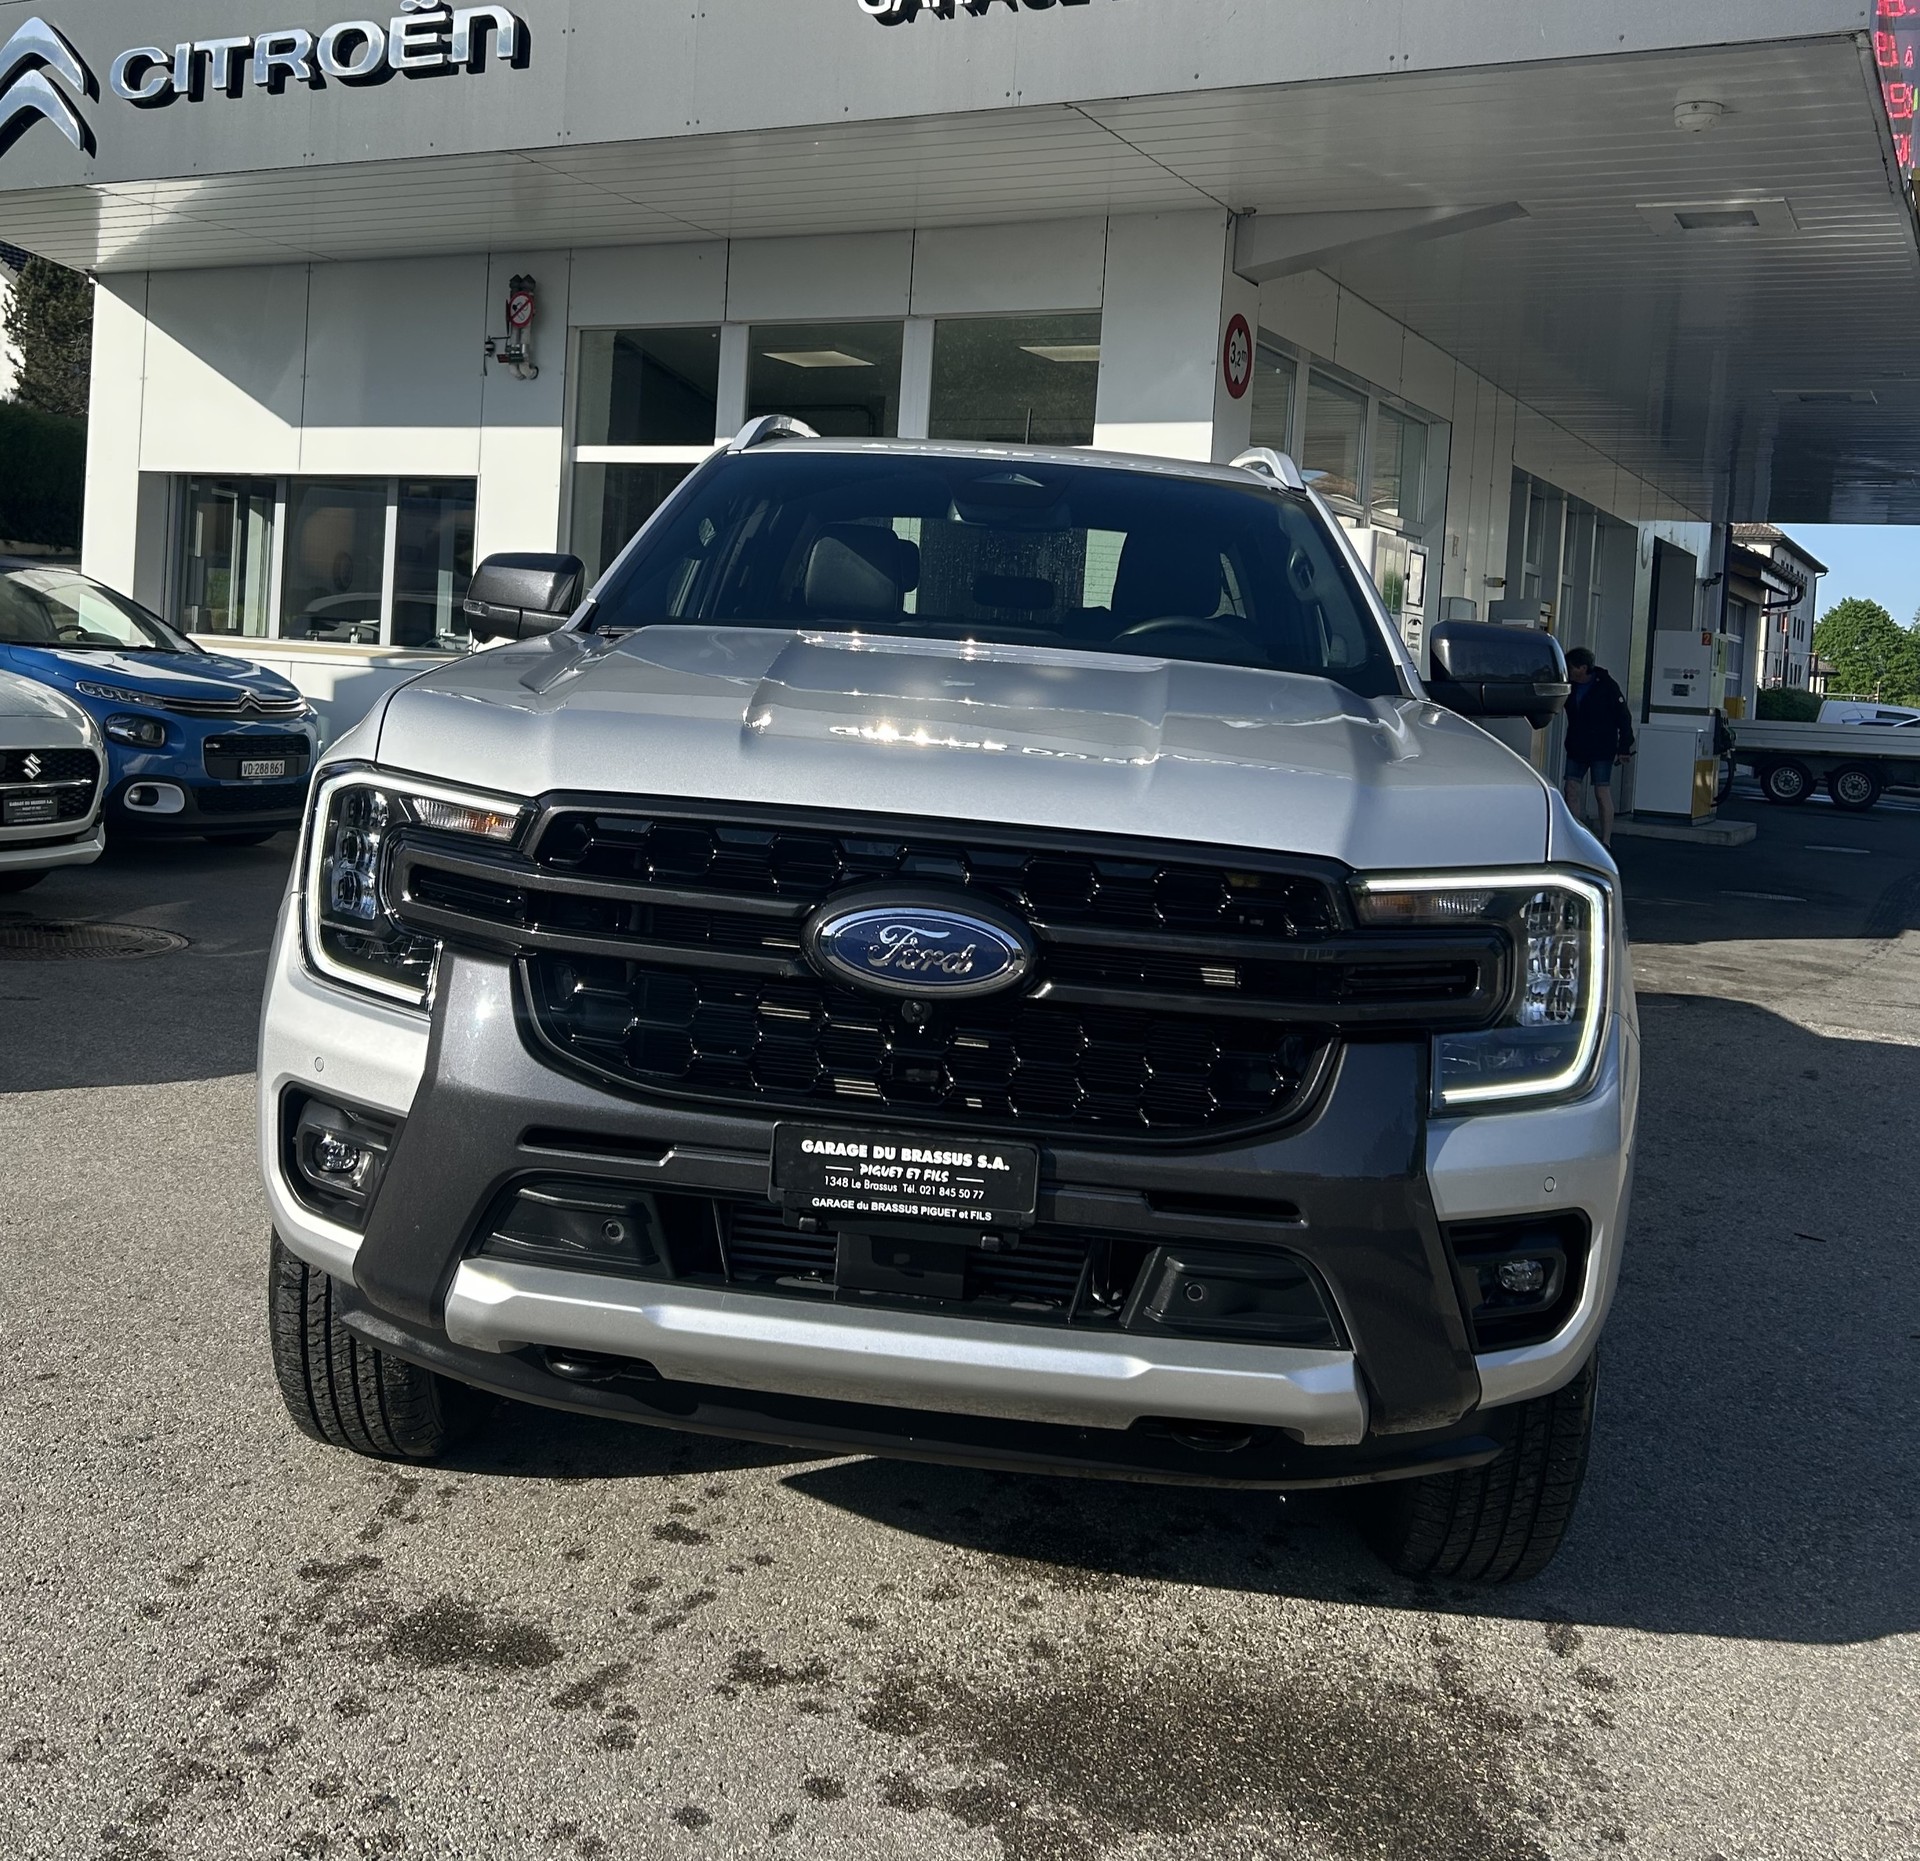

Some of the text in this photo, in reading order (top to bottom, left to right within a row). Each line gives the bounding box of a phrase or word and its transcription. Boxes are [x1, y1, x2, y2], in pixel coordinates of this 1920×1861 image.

[868, 924, 976, 975] Ford
[801, 1139, 1010, 1171] GARAGE DU BRASSUS S.A.
[860, 1163, 949, 1183] PIGUET ET FILS
[825, 1175, 985, 1200] 1348 Le Brassus Tél. 021 845 50 77
[812, 1197, 992, 1221] GARAGE du BRASSUS PIGUET et FILS
